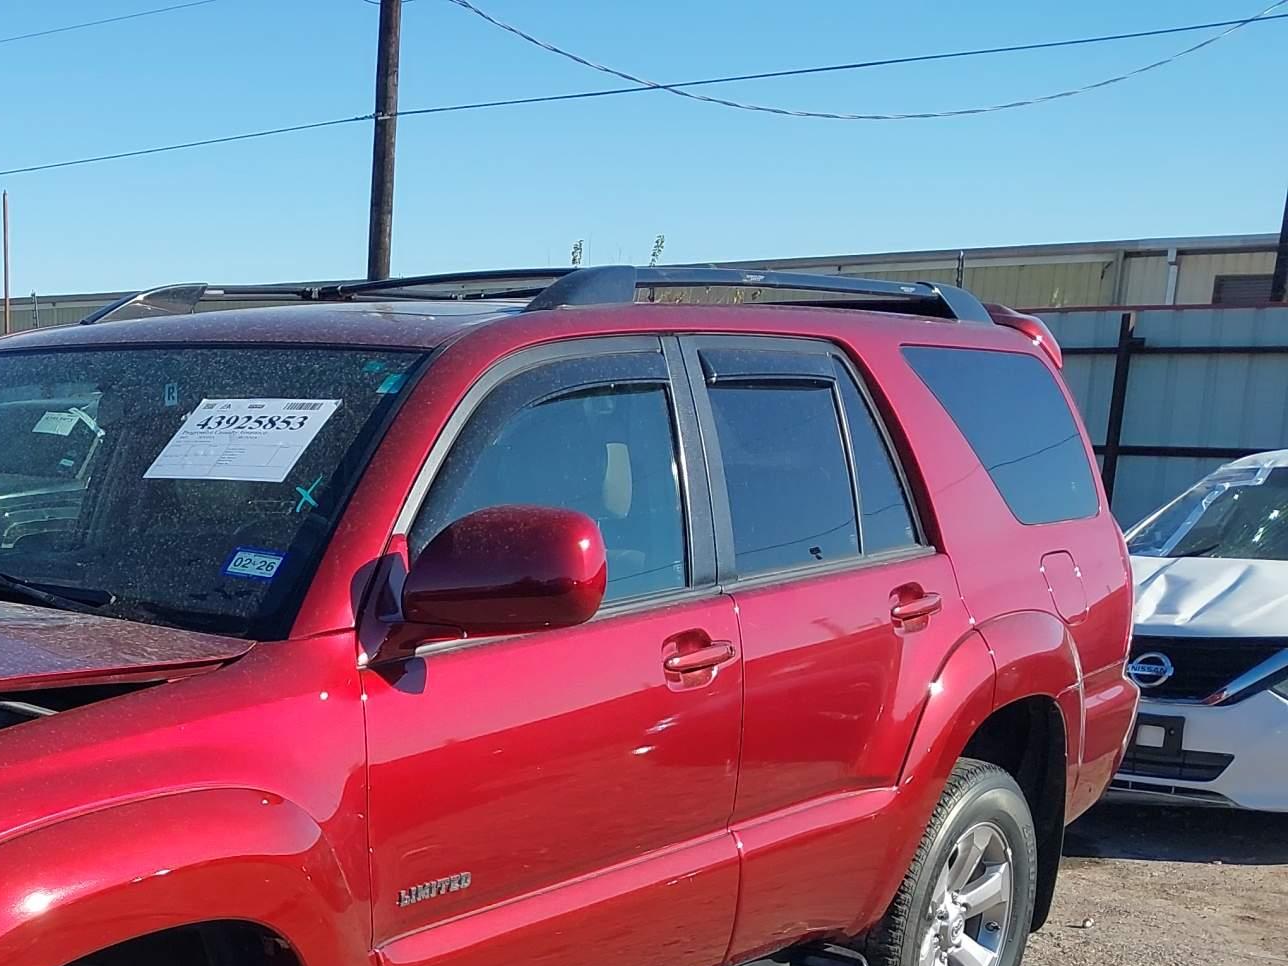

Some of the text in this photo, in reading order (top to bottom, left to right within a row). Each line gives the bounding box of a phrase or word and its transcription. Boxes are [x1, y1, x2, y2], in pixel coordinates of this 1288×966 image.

[196, 415, 306, 431] 43925853
[1131, 665, 1168, 674] NISSAN
[398, 871, 473, 907] LIMITED
